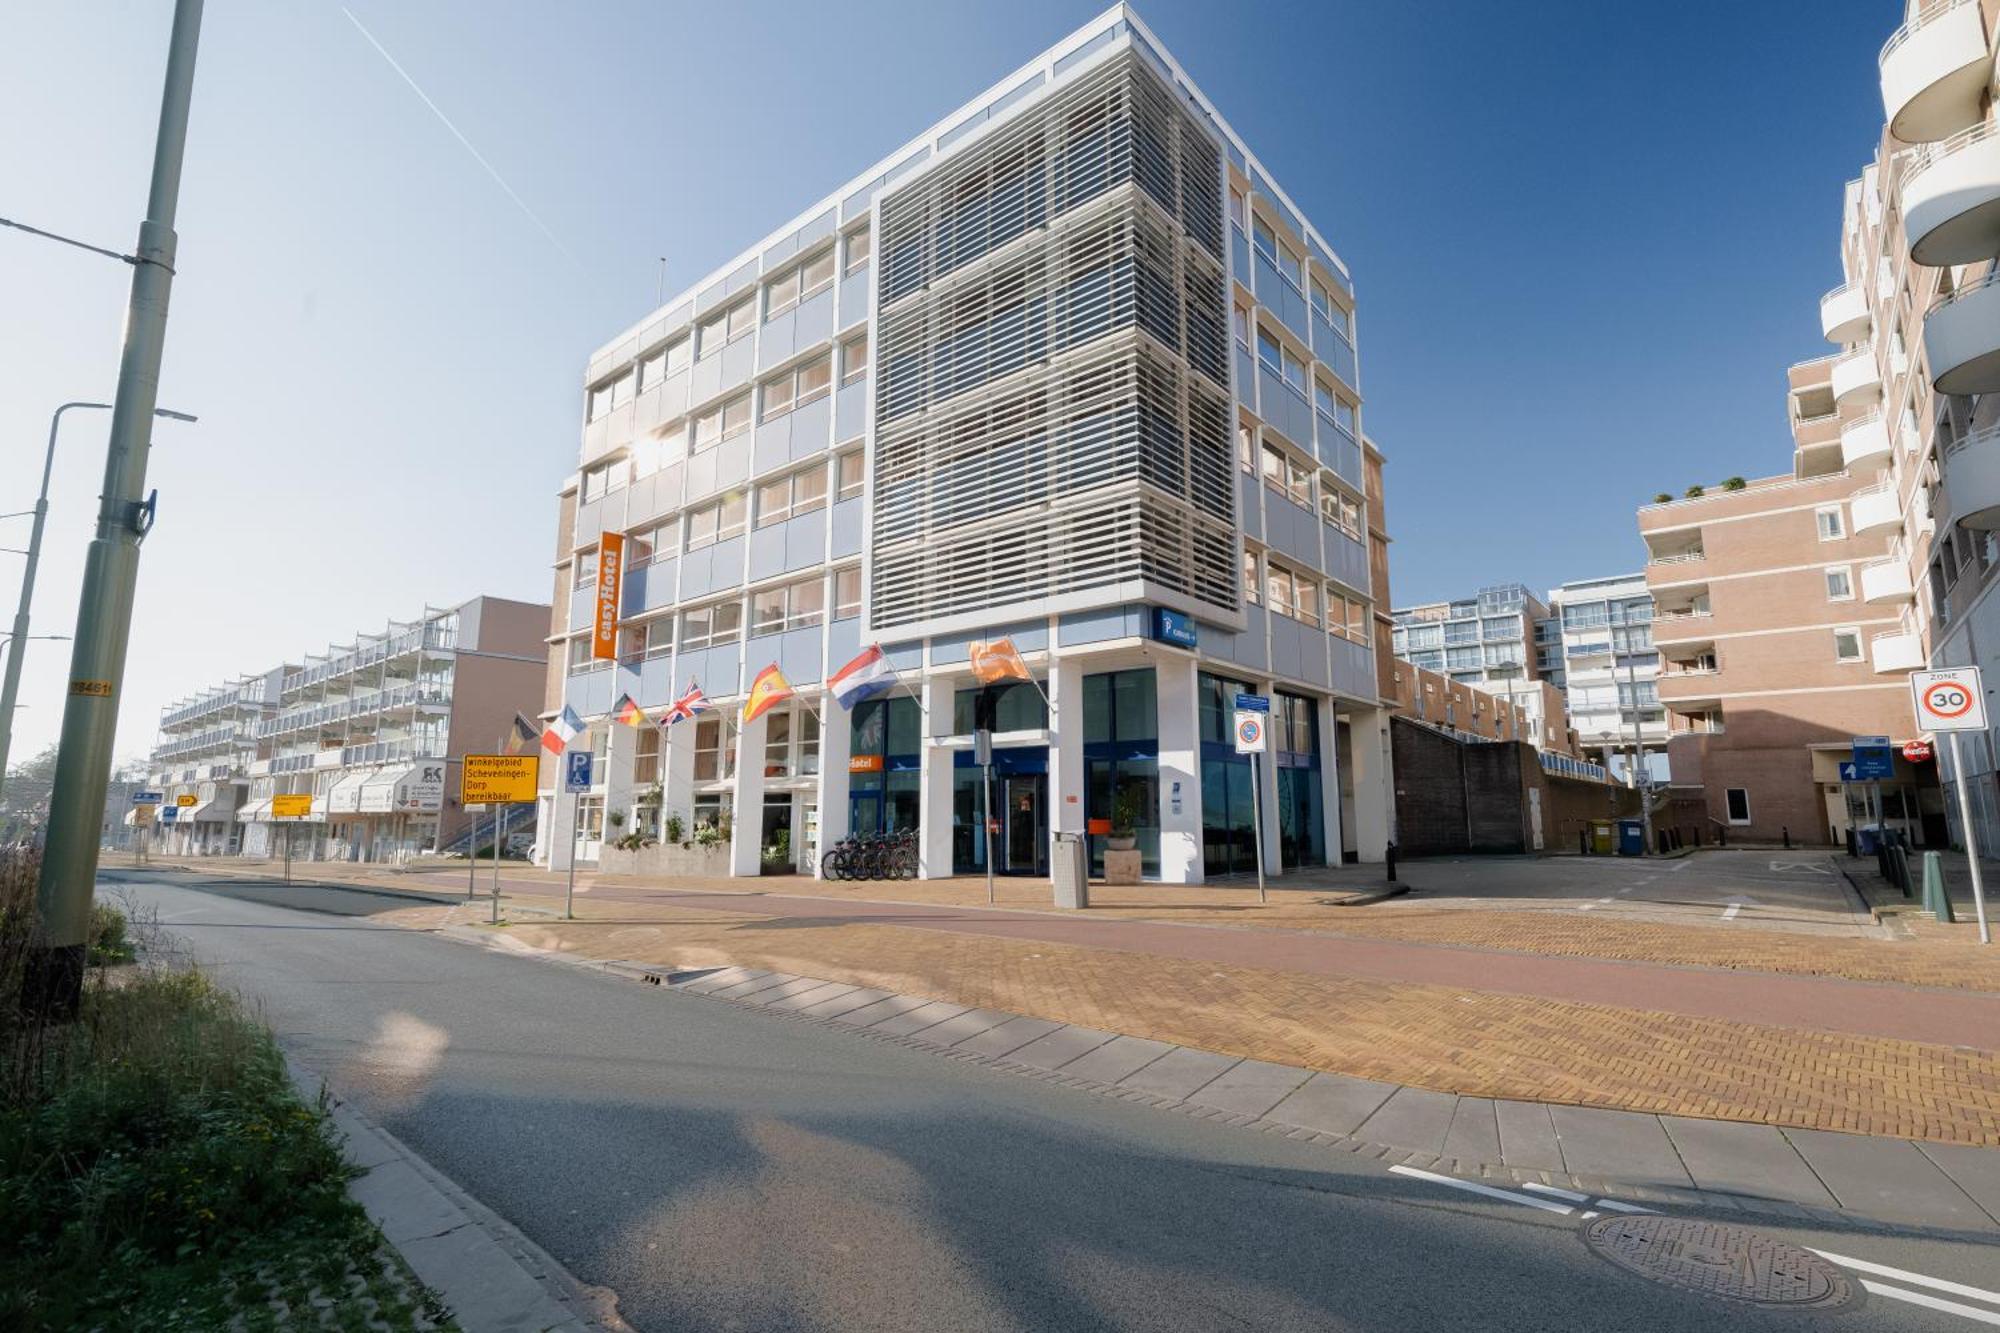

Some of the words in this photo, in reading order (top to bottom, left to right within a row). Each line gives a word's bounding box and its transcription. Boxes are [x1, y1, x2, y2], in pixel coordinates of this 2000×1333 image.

[600, 549, 617, 641] easyHotel
[1929, 672, 1959, 681] ZONE
[1933, 692, 1965, 707] 30
[467, 757, 522, 768] winkelgebied
[573, 753, 588, 772] P
[467, 769, 531, 780] Scheveningen-
[466, 780, 488, 790] Dorp
[465, 791, 513, 801] bereikbaar
